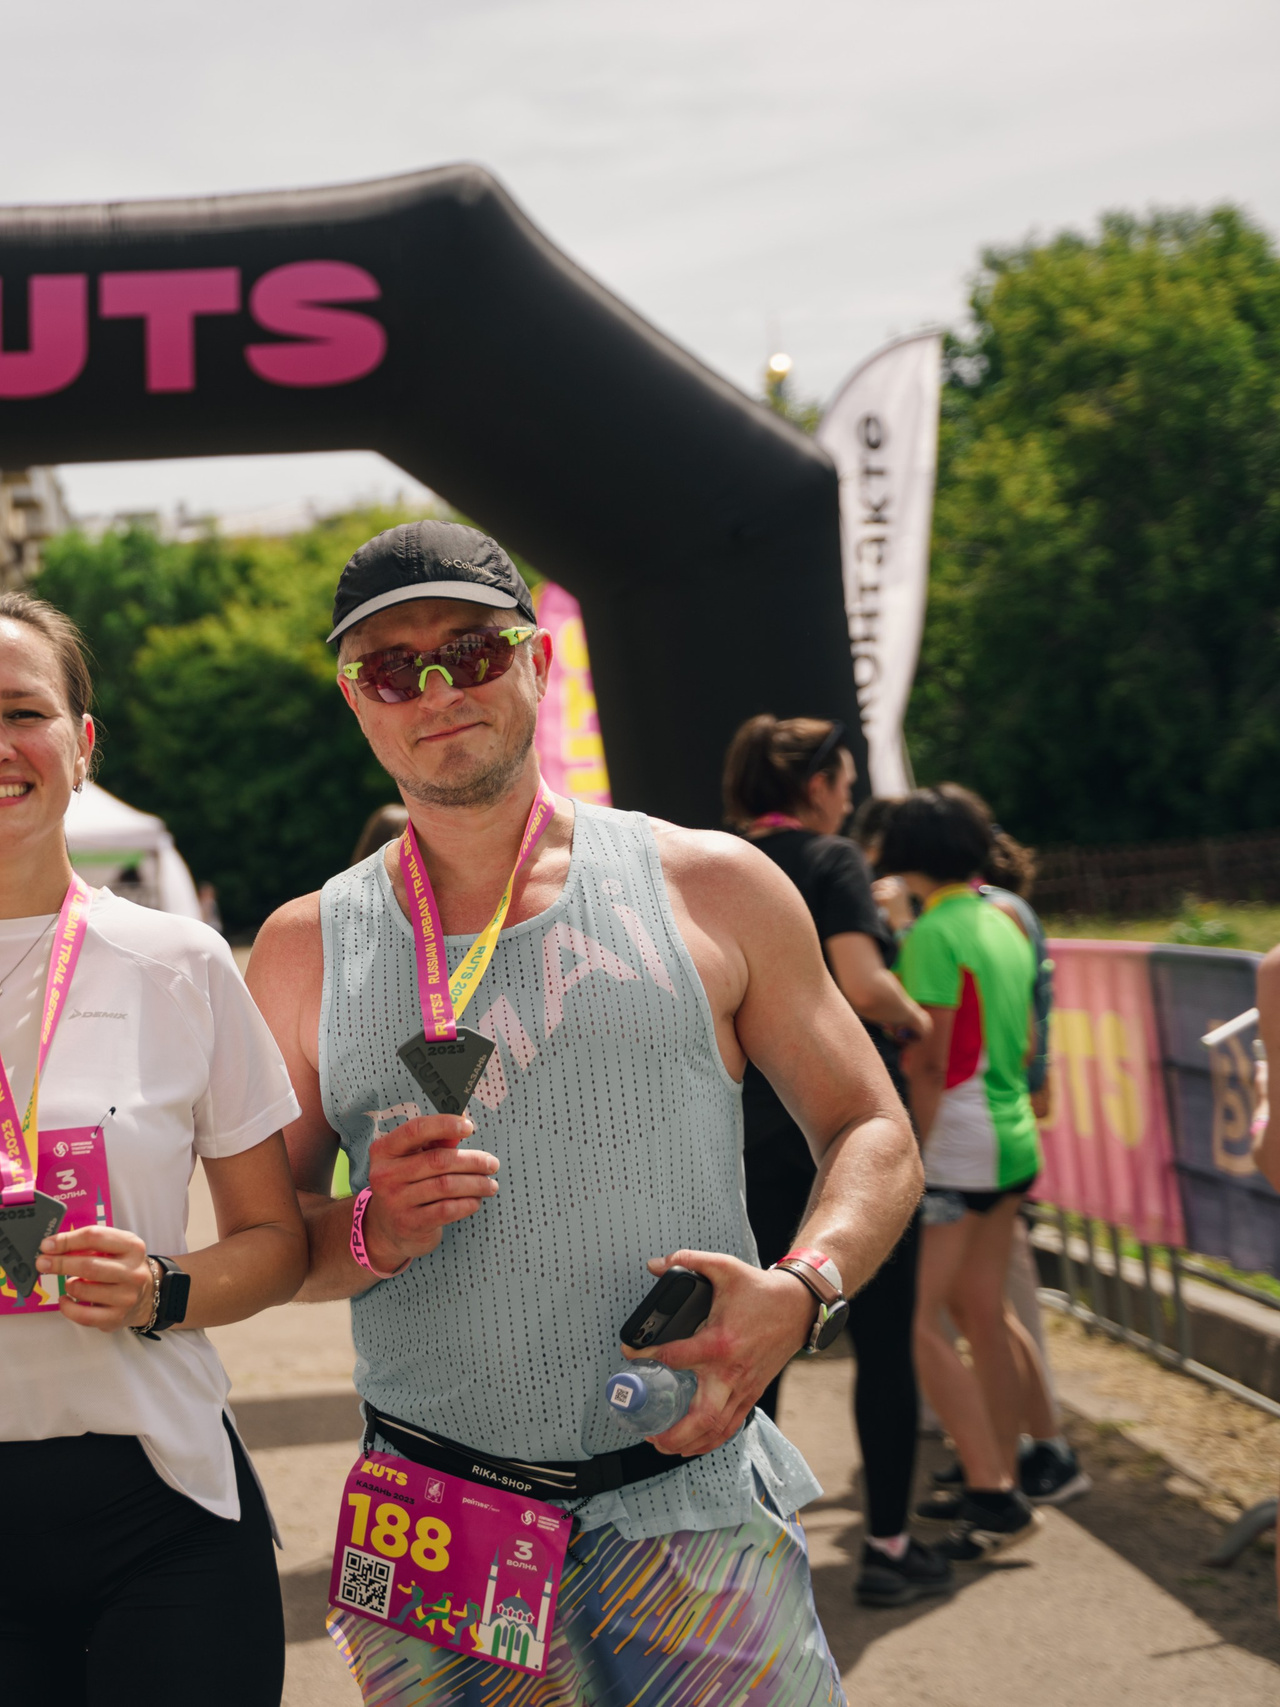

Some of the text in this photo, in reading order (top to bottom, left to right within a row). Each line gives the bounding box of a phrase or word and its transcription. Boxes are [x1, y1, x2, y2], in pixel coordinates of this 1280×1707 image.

[854, 414, 887, 726] онтакте
[407, 853, 425, 899] TRAIL
[63, 894, 87, 943] URBAN
[418, 896, 436, 944] URBAN
[53, 943, 73, 985] TRAIL
[427, 942, 441, 985] RUSSIAN
[461, 945, 487, 981] RUTS
[42, 987, 61, 1045] SERIES
[81, 1011, 128, 1020] DEMIX
[427, 1044, 465, 1056] 2023
[405, 1046, 460, 1114] RUTS
[463, 1053, 487, 1094] КАЗАНЬ
[1, 1119, 20, 1158] 2023
[56, 1168, 78, 1191] 3
[355, 1480, 415, 1505] КАЗАНЬ 2023
[360, 1460, 408, 1486] RUTS
[471, 1464, 532, 1492] RIKA-SHOP
[348, 1493, 452, 1572] 188
[513, 1539, 533, 1561] 3
[506, 1559, 538, 1572] ВОЛНА
